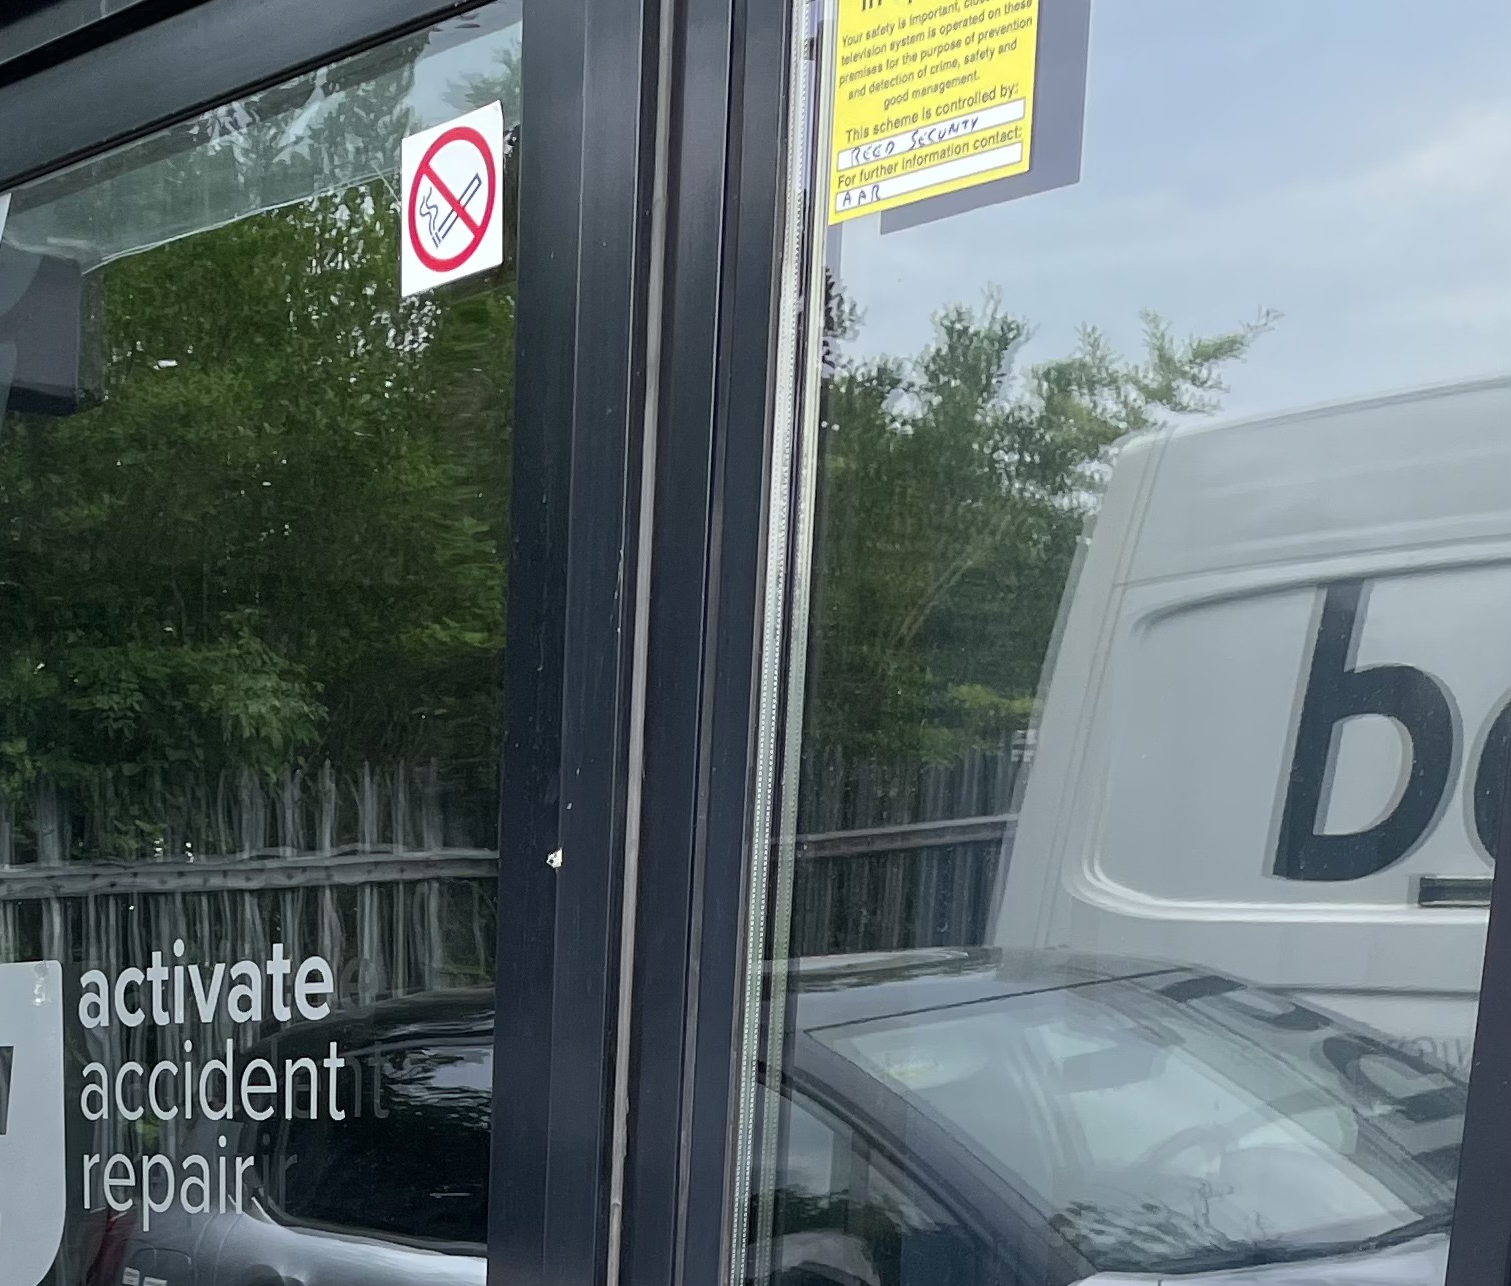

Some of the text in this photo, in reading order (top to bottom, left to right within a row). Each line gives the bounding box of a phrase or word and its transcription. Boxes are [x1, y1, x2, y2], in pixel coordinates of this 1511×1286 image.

[839, 16, 1032, 88] premises for the purpose of prevention
[841, 43, 886, 66] television
[890, 31, 925, 52] system
[928, 26, 936, 39] is
[939, 9, 985, 36] operated
[988, 8, 1001, 20] on
[1004, 0, 1032, 17] these
[842, 32, 863, 48] Your
[866, 22, 895, 40] safety
[898, 17, 906, 30] is
[909, 2, 960, 26] important,
[848, 37, 1017, 100] and detection of crime, safety and
[884, 88, 909, 111] good
[846, 83, 1018, 143] This scheme is controlled by:
[838, 125, 1022, 189] For further information contact:
[77, 939, 335, 1028] activate
[80, 1038, 346, 1121] accident
[83, 1135, 255, 1231] repair
